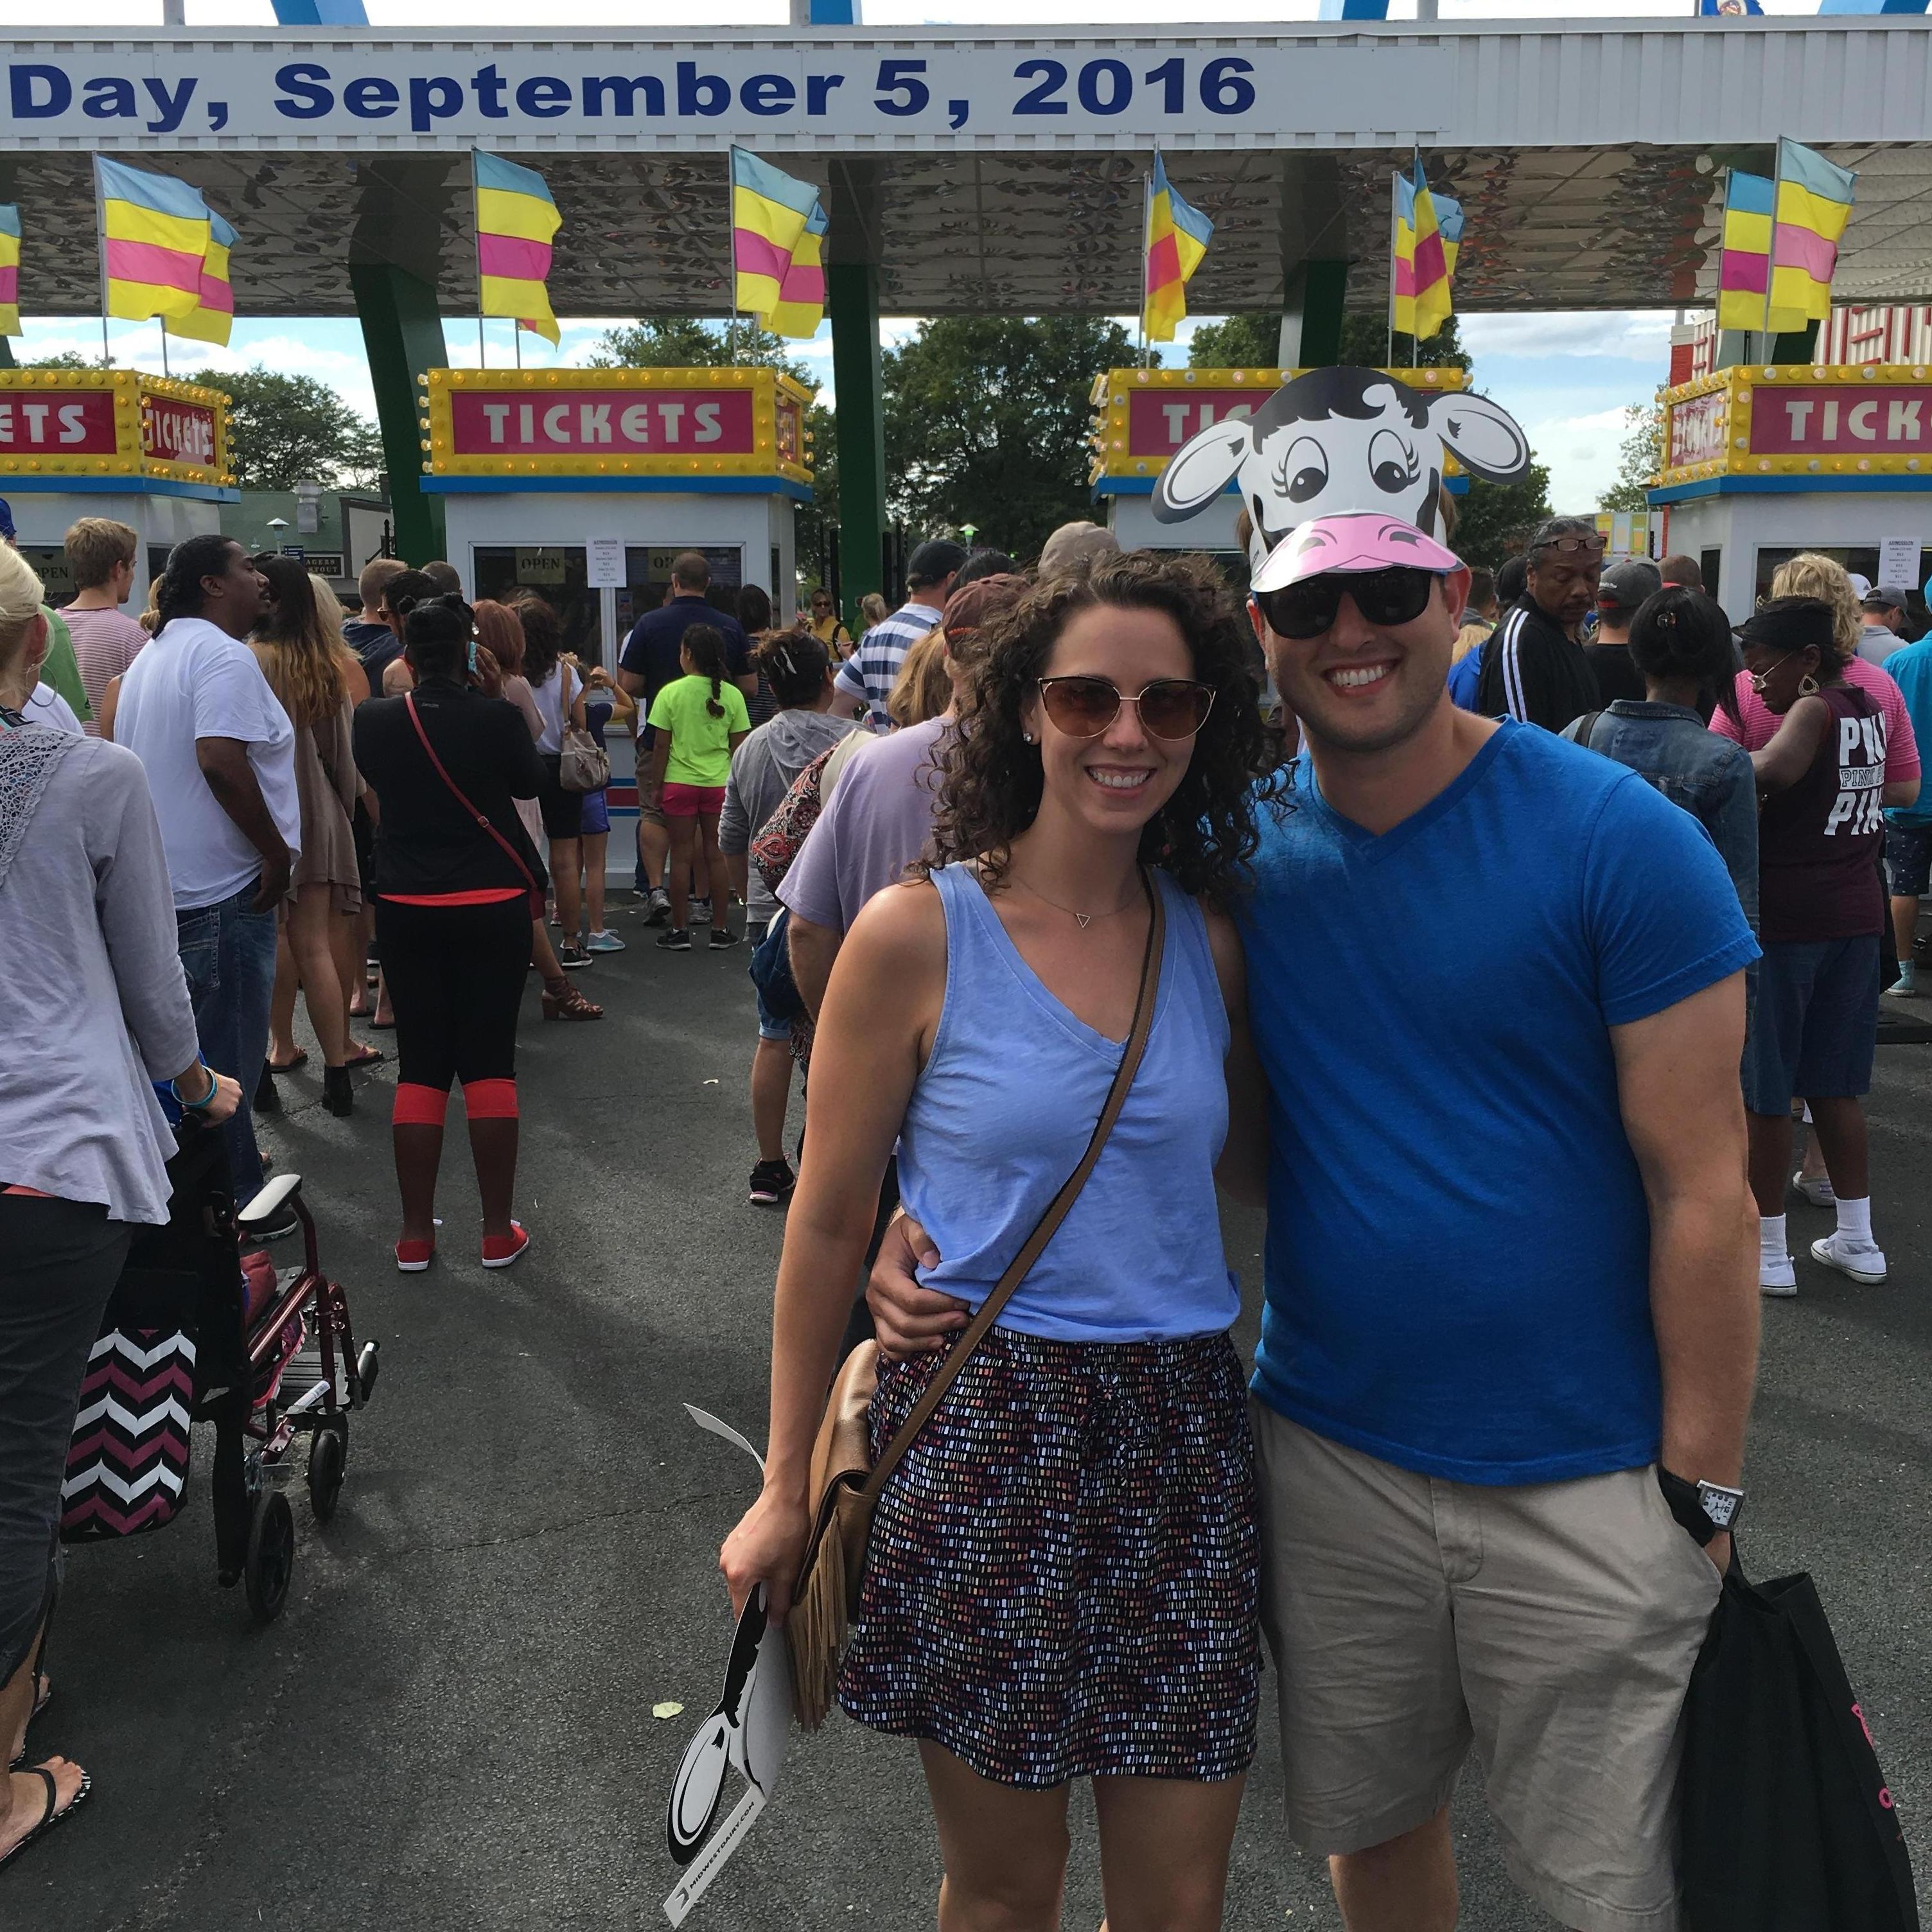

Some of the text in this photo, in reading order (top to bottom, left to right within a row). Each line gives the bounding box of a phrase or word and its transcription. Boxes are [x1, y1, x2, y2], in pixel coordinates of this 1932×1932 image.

[10, 58, 1256, 132] Day, September 5, 2016
[145, 408, 214, 455] TICKETS
[483, 403, 722, 443] TICKETS
[522, 558, 559, 570] OPEN
[690, 1801, 754, 1889] MIDWESTDAIRY.COM
